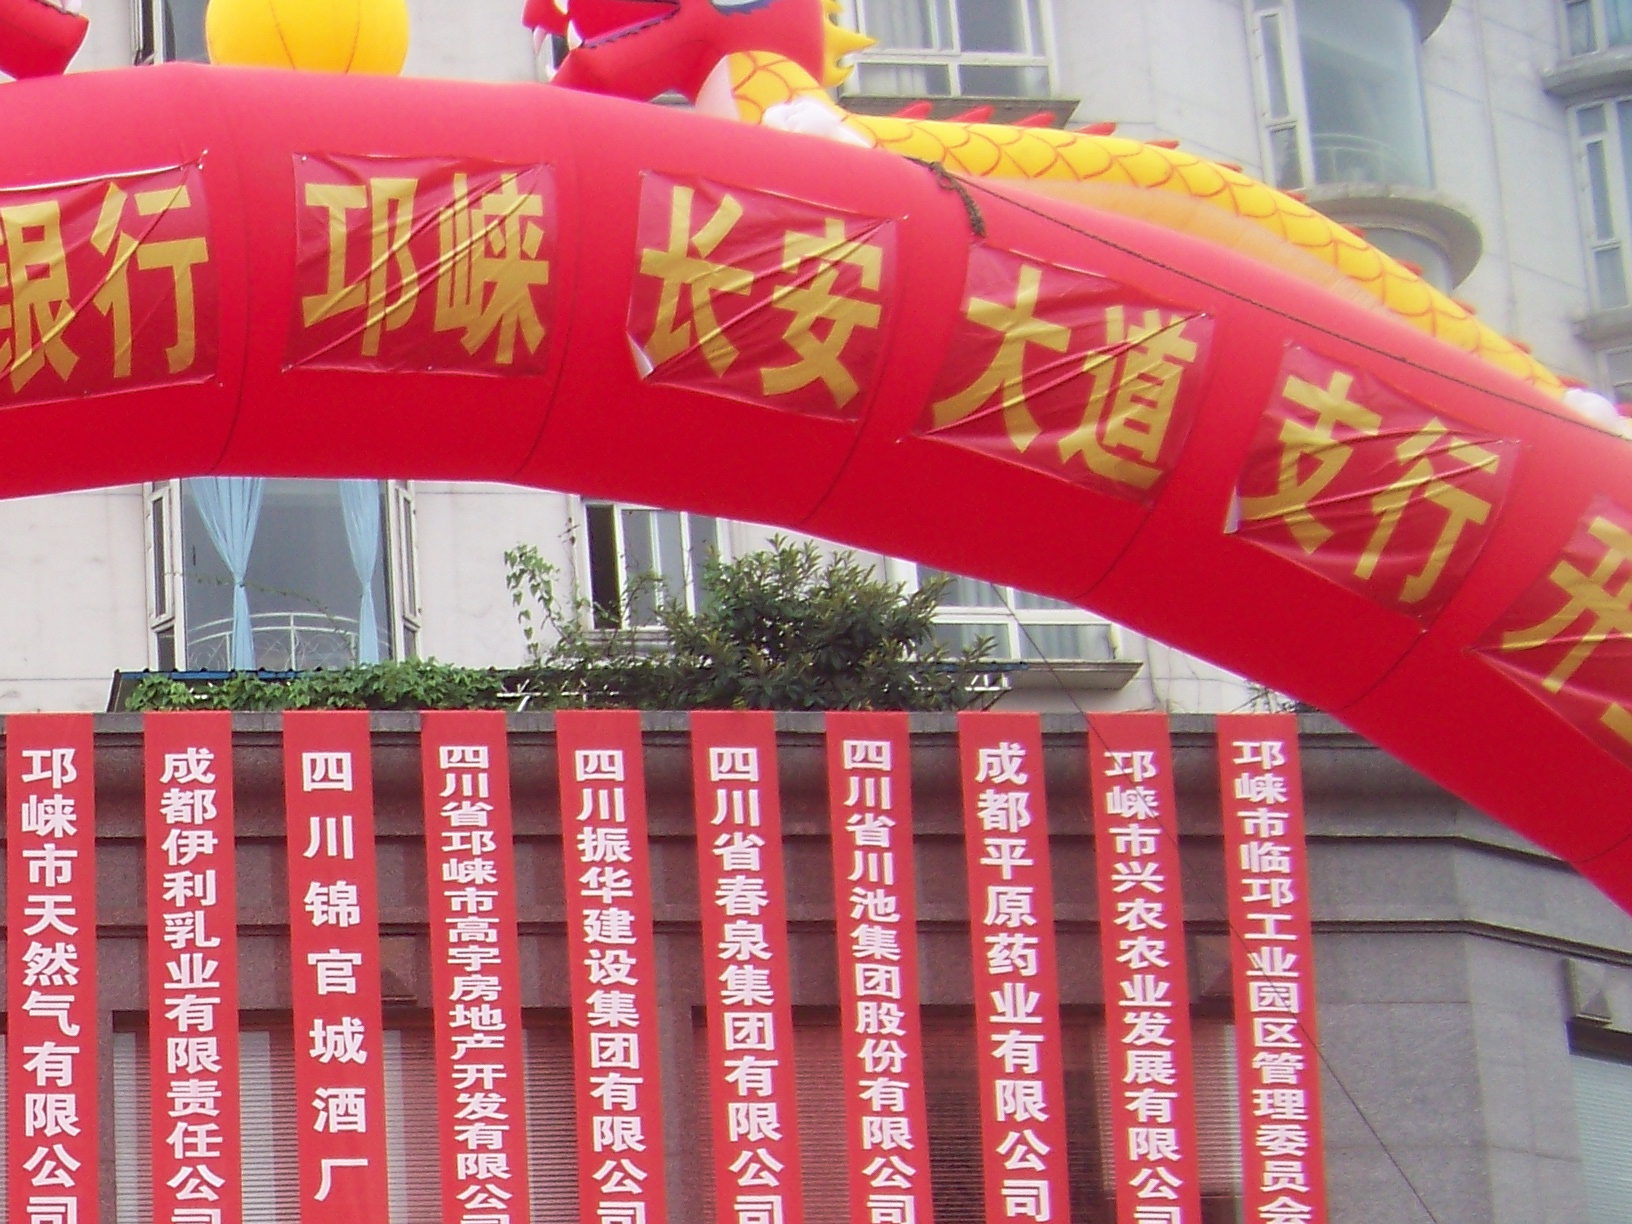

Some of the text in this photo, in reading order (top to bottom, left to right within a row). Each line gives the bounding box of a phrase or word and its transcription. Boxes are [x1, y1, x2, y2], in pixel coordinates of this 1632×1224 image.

[302, 172, 550, 365] 邛崃
[639, 185, 883, 410] 长安
[933, 264, 1199, 491] 大道
[1238, 371, 1501, 603] 支行
